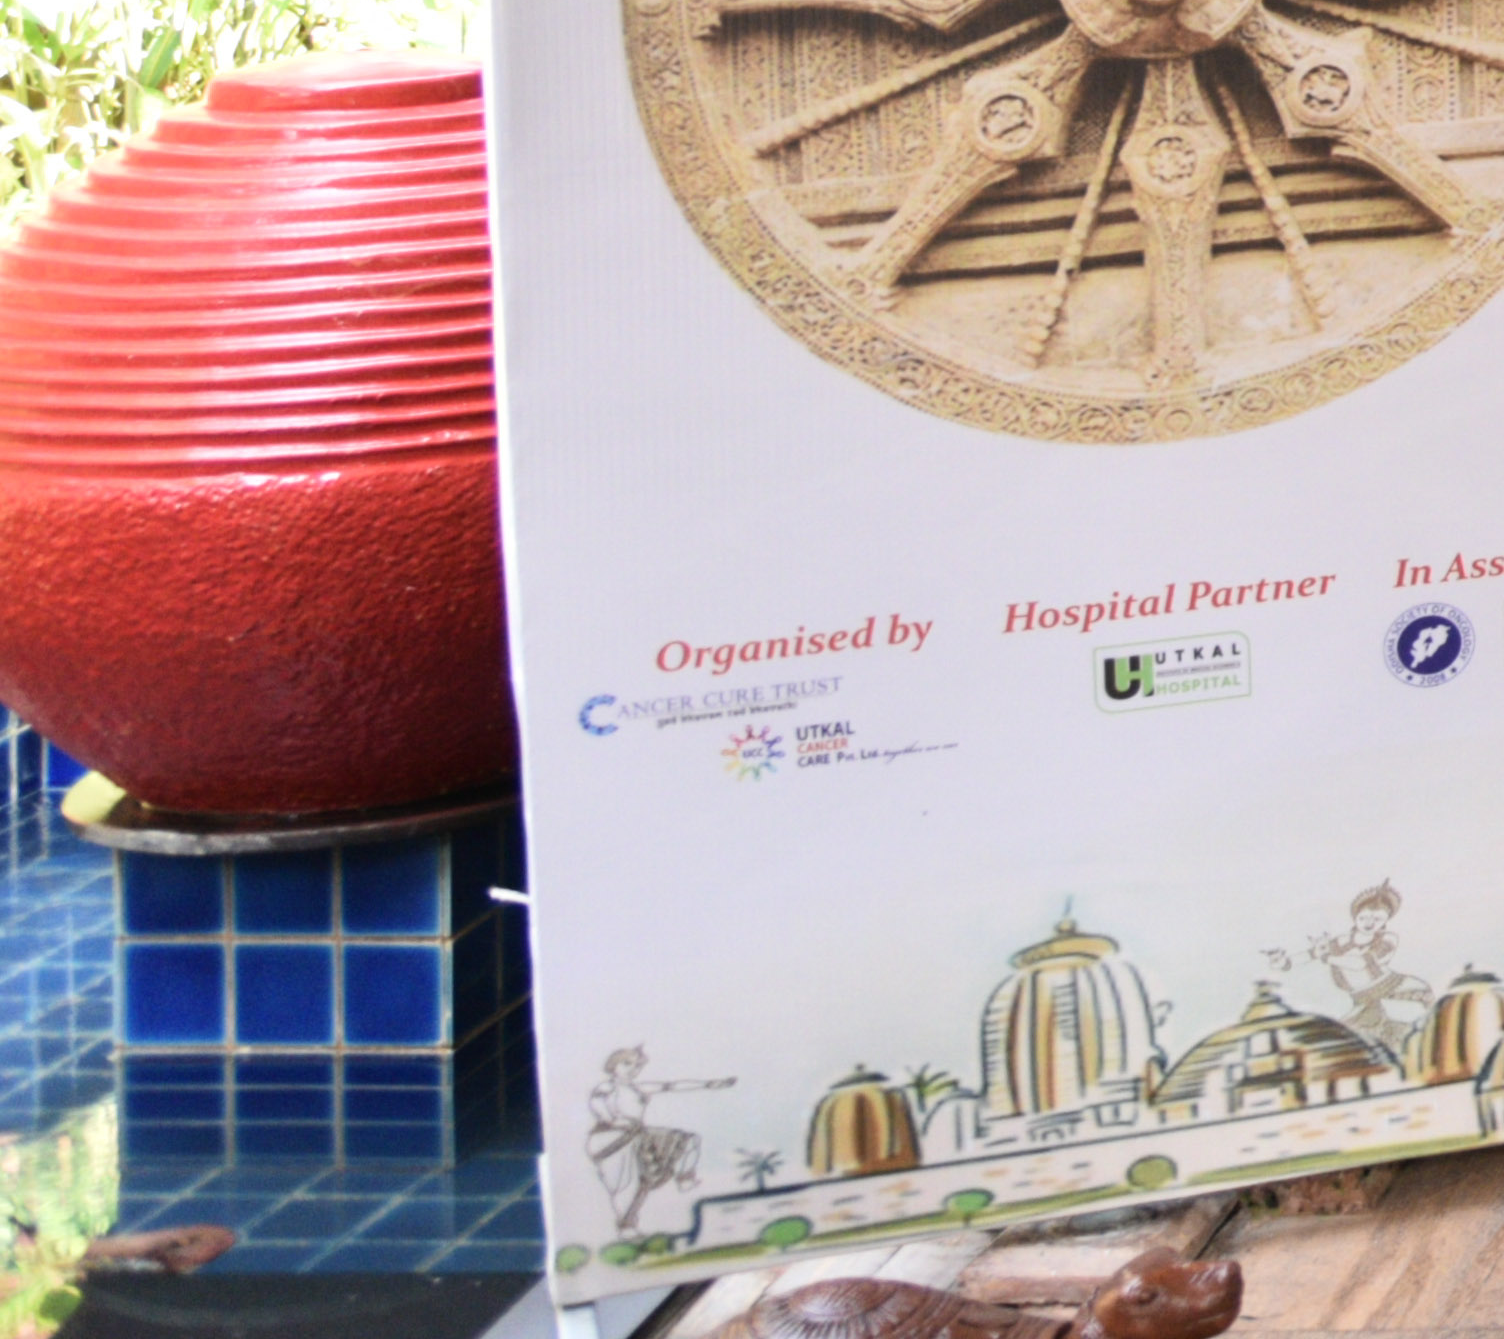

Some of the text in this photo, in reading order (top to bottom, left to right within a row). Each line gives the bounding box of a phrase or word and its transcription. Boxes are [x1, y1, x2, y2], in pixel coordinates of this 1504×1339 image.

[1395, 559, 1431, 587] In
[1004, 575, 1336, 633] Hospital Partner
[656, 614, 932, 675] Organised by
[1155, 643, 1241, 664] UTKAL
[703, 686, 766, 709] CURE
[771, 677, 844, 700] TRUST
[1156, 675, 1241, 694] HOSPITAL
[796, 721, 855, 741] UTKAL
[797, 738, 848, 754] CANCER
[798, 753, 830, 768] CARE
